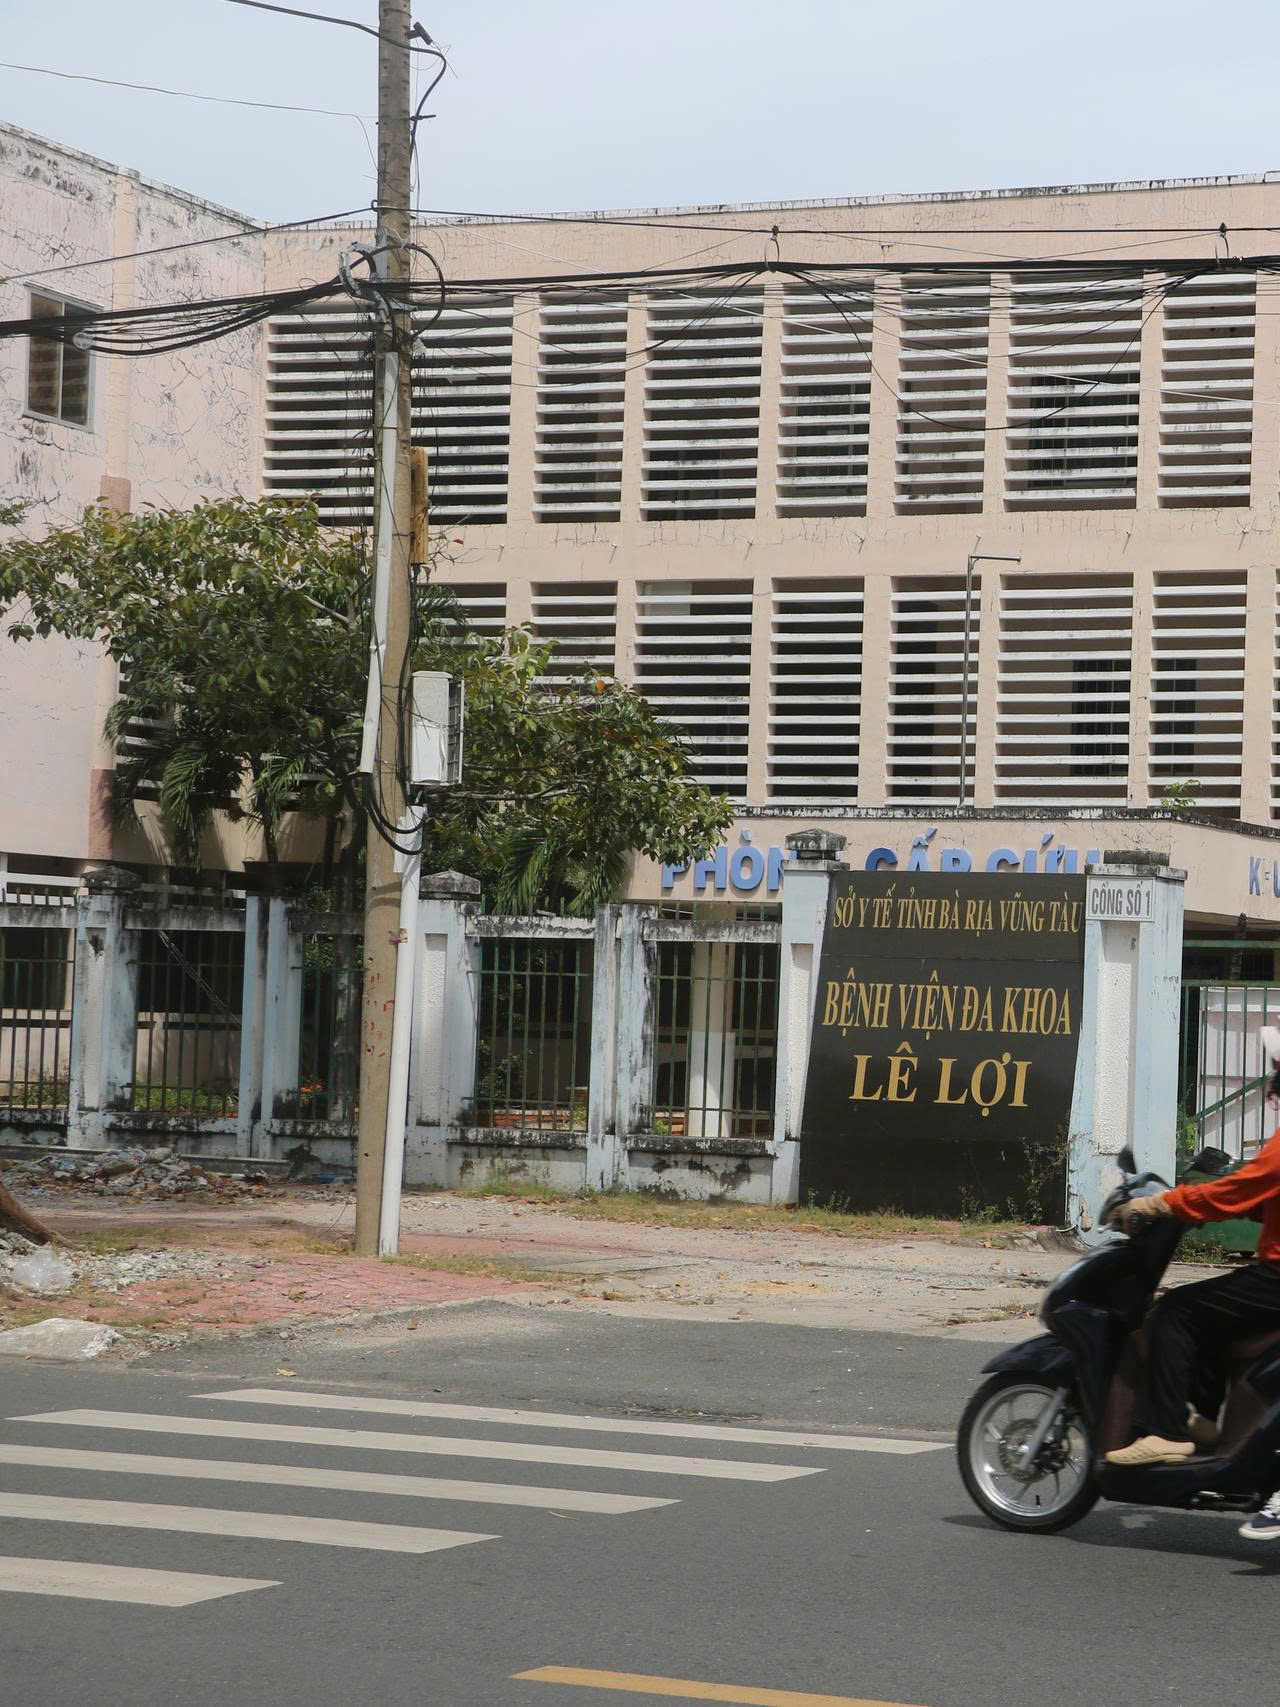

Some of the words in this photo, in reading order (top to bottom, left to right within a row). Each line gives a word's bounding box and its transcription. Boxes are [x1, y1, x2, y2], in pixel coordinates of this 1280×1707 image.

[833, 885, 856, 928] SỞ
[858, 898, 870, 928] Y
[872, 883, 896, 928] TẾ
[897, 886, 936, 929] TỈNH
[938, 889, 960, 930] BÀ
[964, 899, 994, 937] RỊA
[999, 892, 1046, 932] VŨNG
[1048, 891, 1083, 933] TÀU
[1091, 881, 1123, 915] CỔNG
[1126, 881, 1143, 916] SỐ
[1145, 890, 1151, 916] 1
[822, 967, 893, 1037] BỆNH
[899, 970, 959, 1040] VIỆN
[959, 985, 994, 1032] ĐA
[1000, 987, 1072, 1035] KHOA
[848, 1041, 918, 1102] LÊ
[933, 1052, 1032, 1117] LỢI
